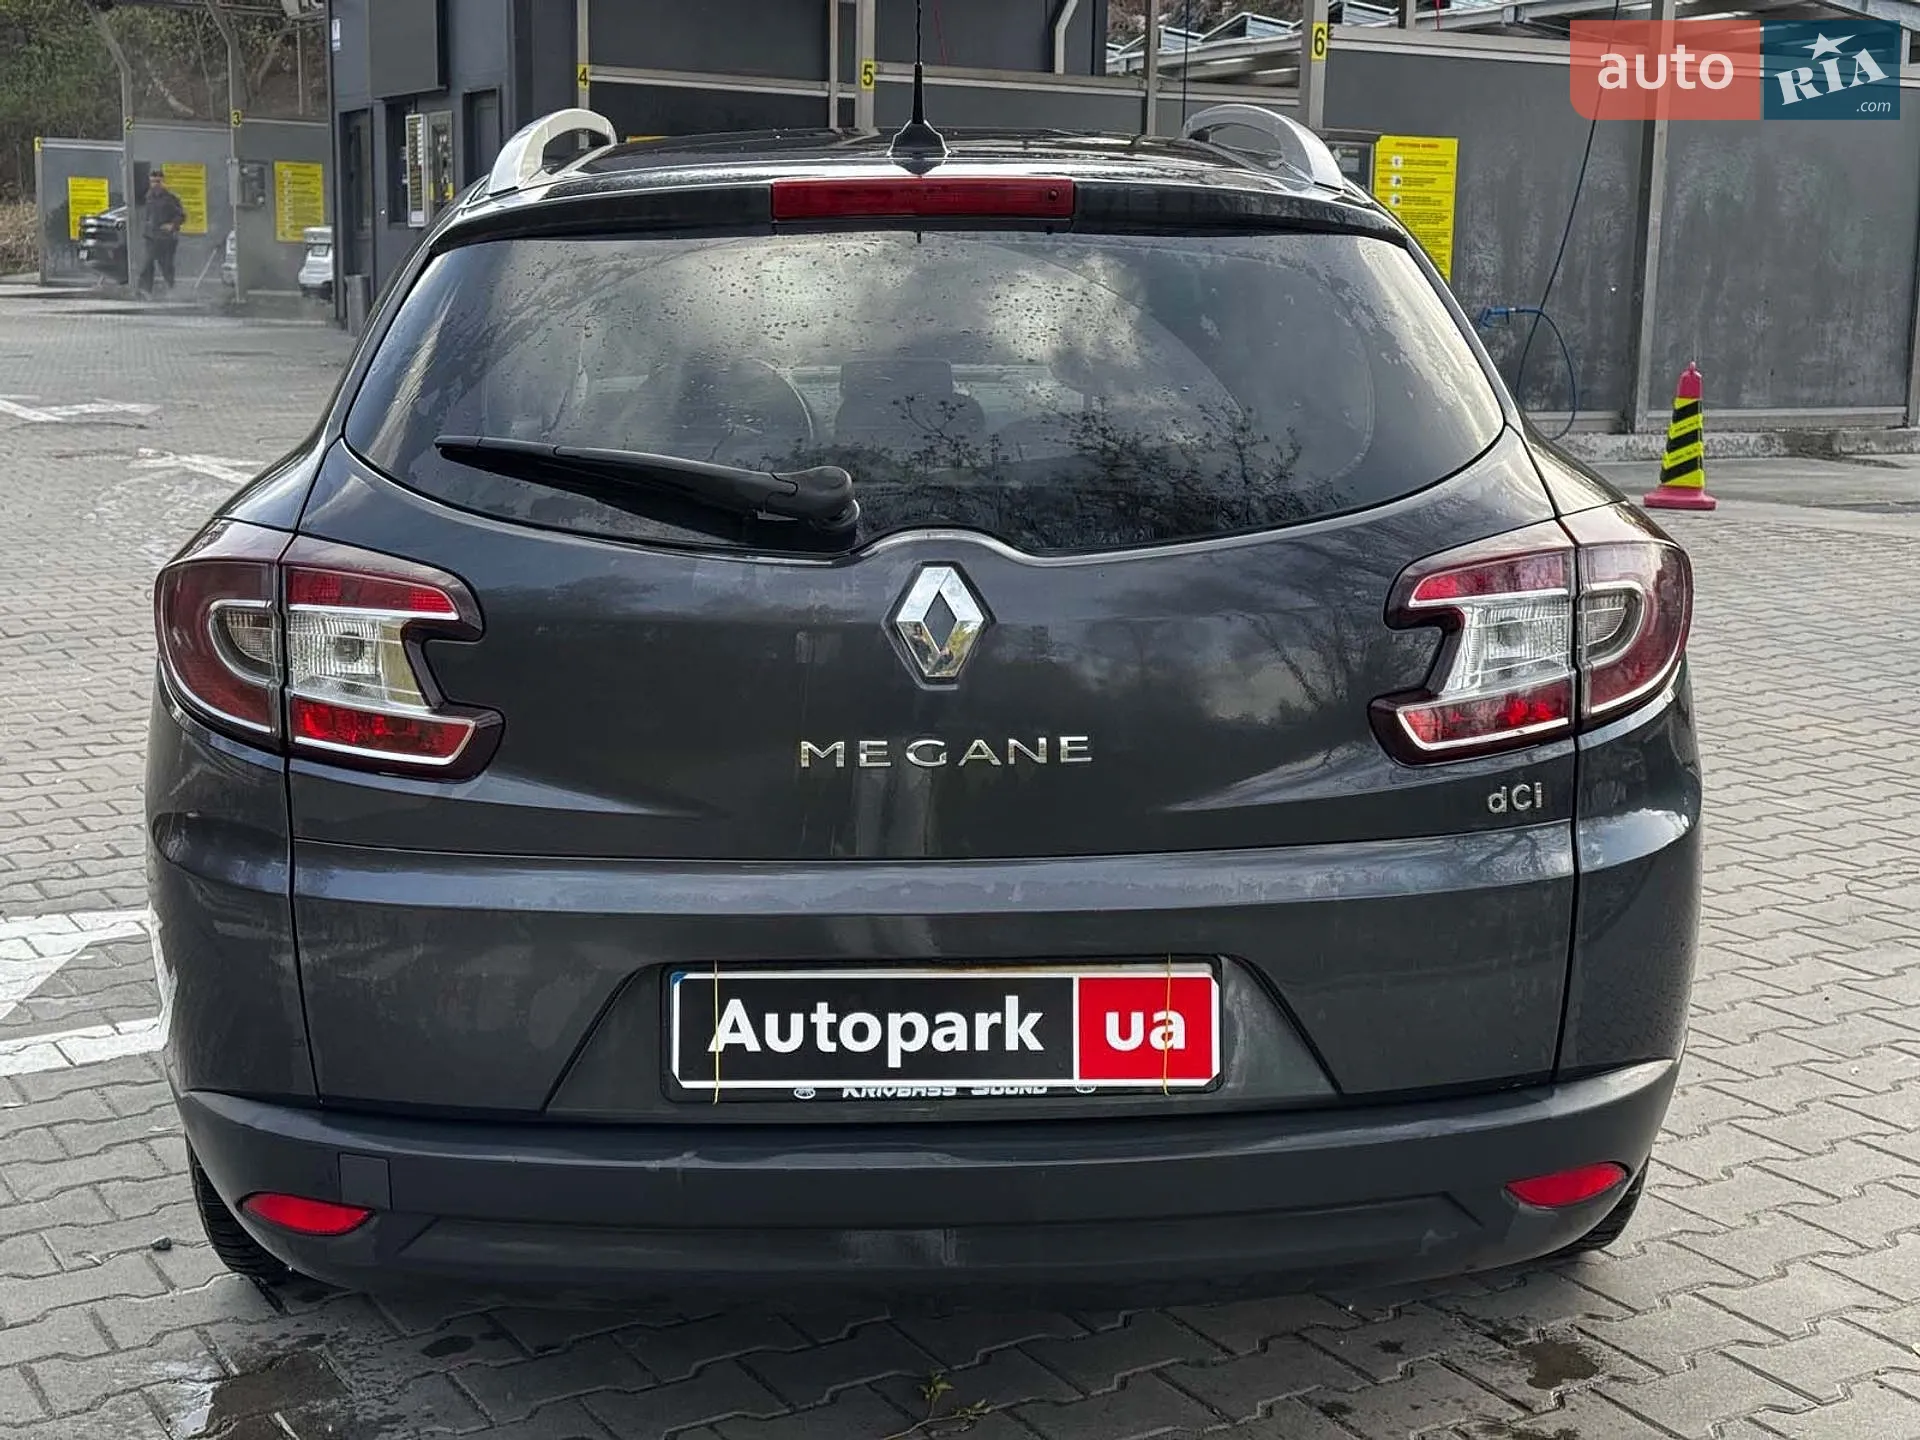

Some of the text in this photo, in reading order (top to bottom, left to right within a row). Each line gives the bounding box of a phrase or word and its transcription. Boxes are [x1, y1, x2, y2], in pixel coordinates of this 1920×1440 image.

[1314, 27, 1325, 56] 6
[579, 66, 588, 87] 4
[862, 63, 874, 86] 5
[125, 118, 133, 131] 2
[232, 112, 241, 126] 3
[800, 735, 1093, 768] MEGANE
[1487, 781, 1543, 814] dCi
[707, 994, 1187, 1069] Autopark ua
